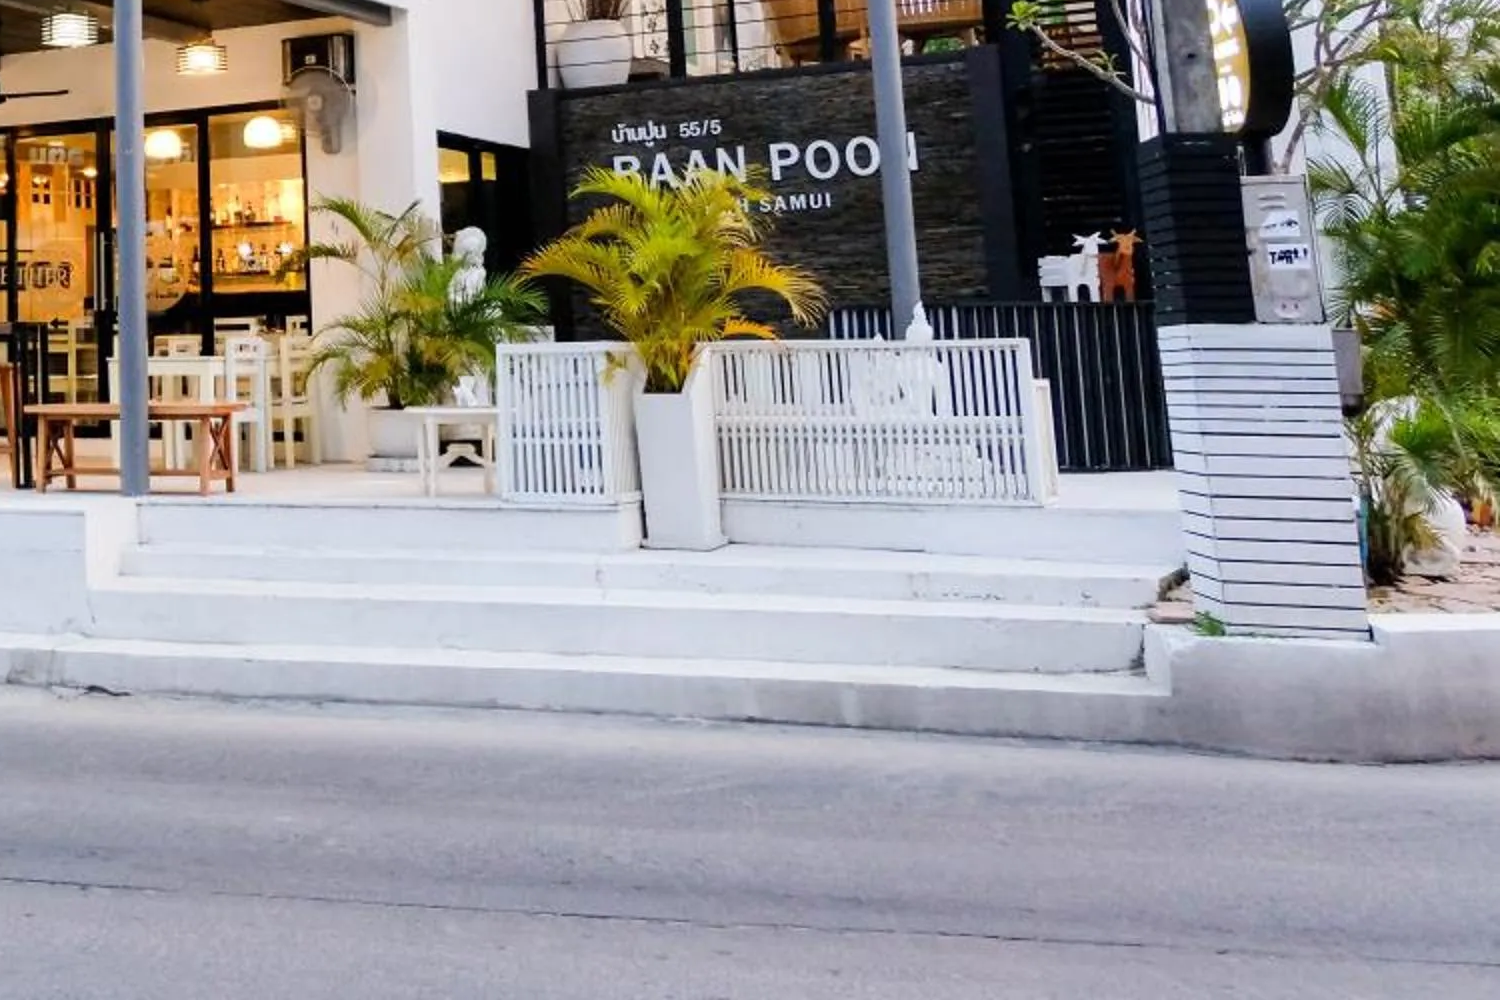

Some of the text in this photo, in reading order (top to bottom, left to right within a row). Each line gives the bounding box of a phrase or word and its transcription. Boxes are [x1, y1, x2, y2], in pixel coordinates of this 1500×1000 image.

[611, 119, 722, 147] บ้านปูน 55/5
[613, 145, 747, 190] BAAN
[759, 191, 832, 213] SAMUI
